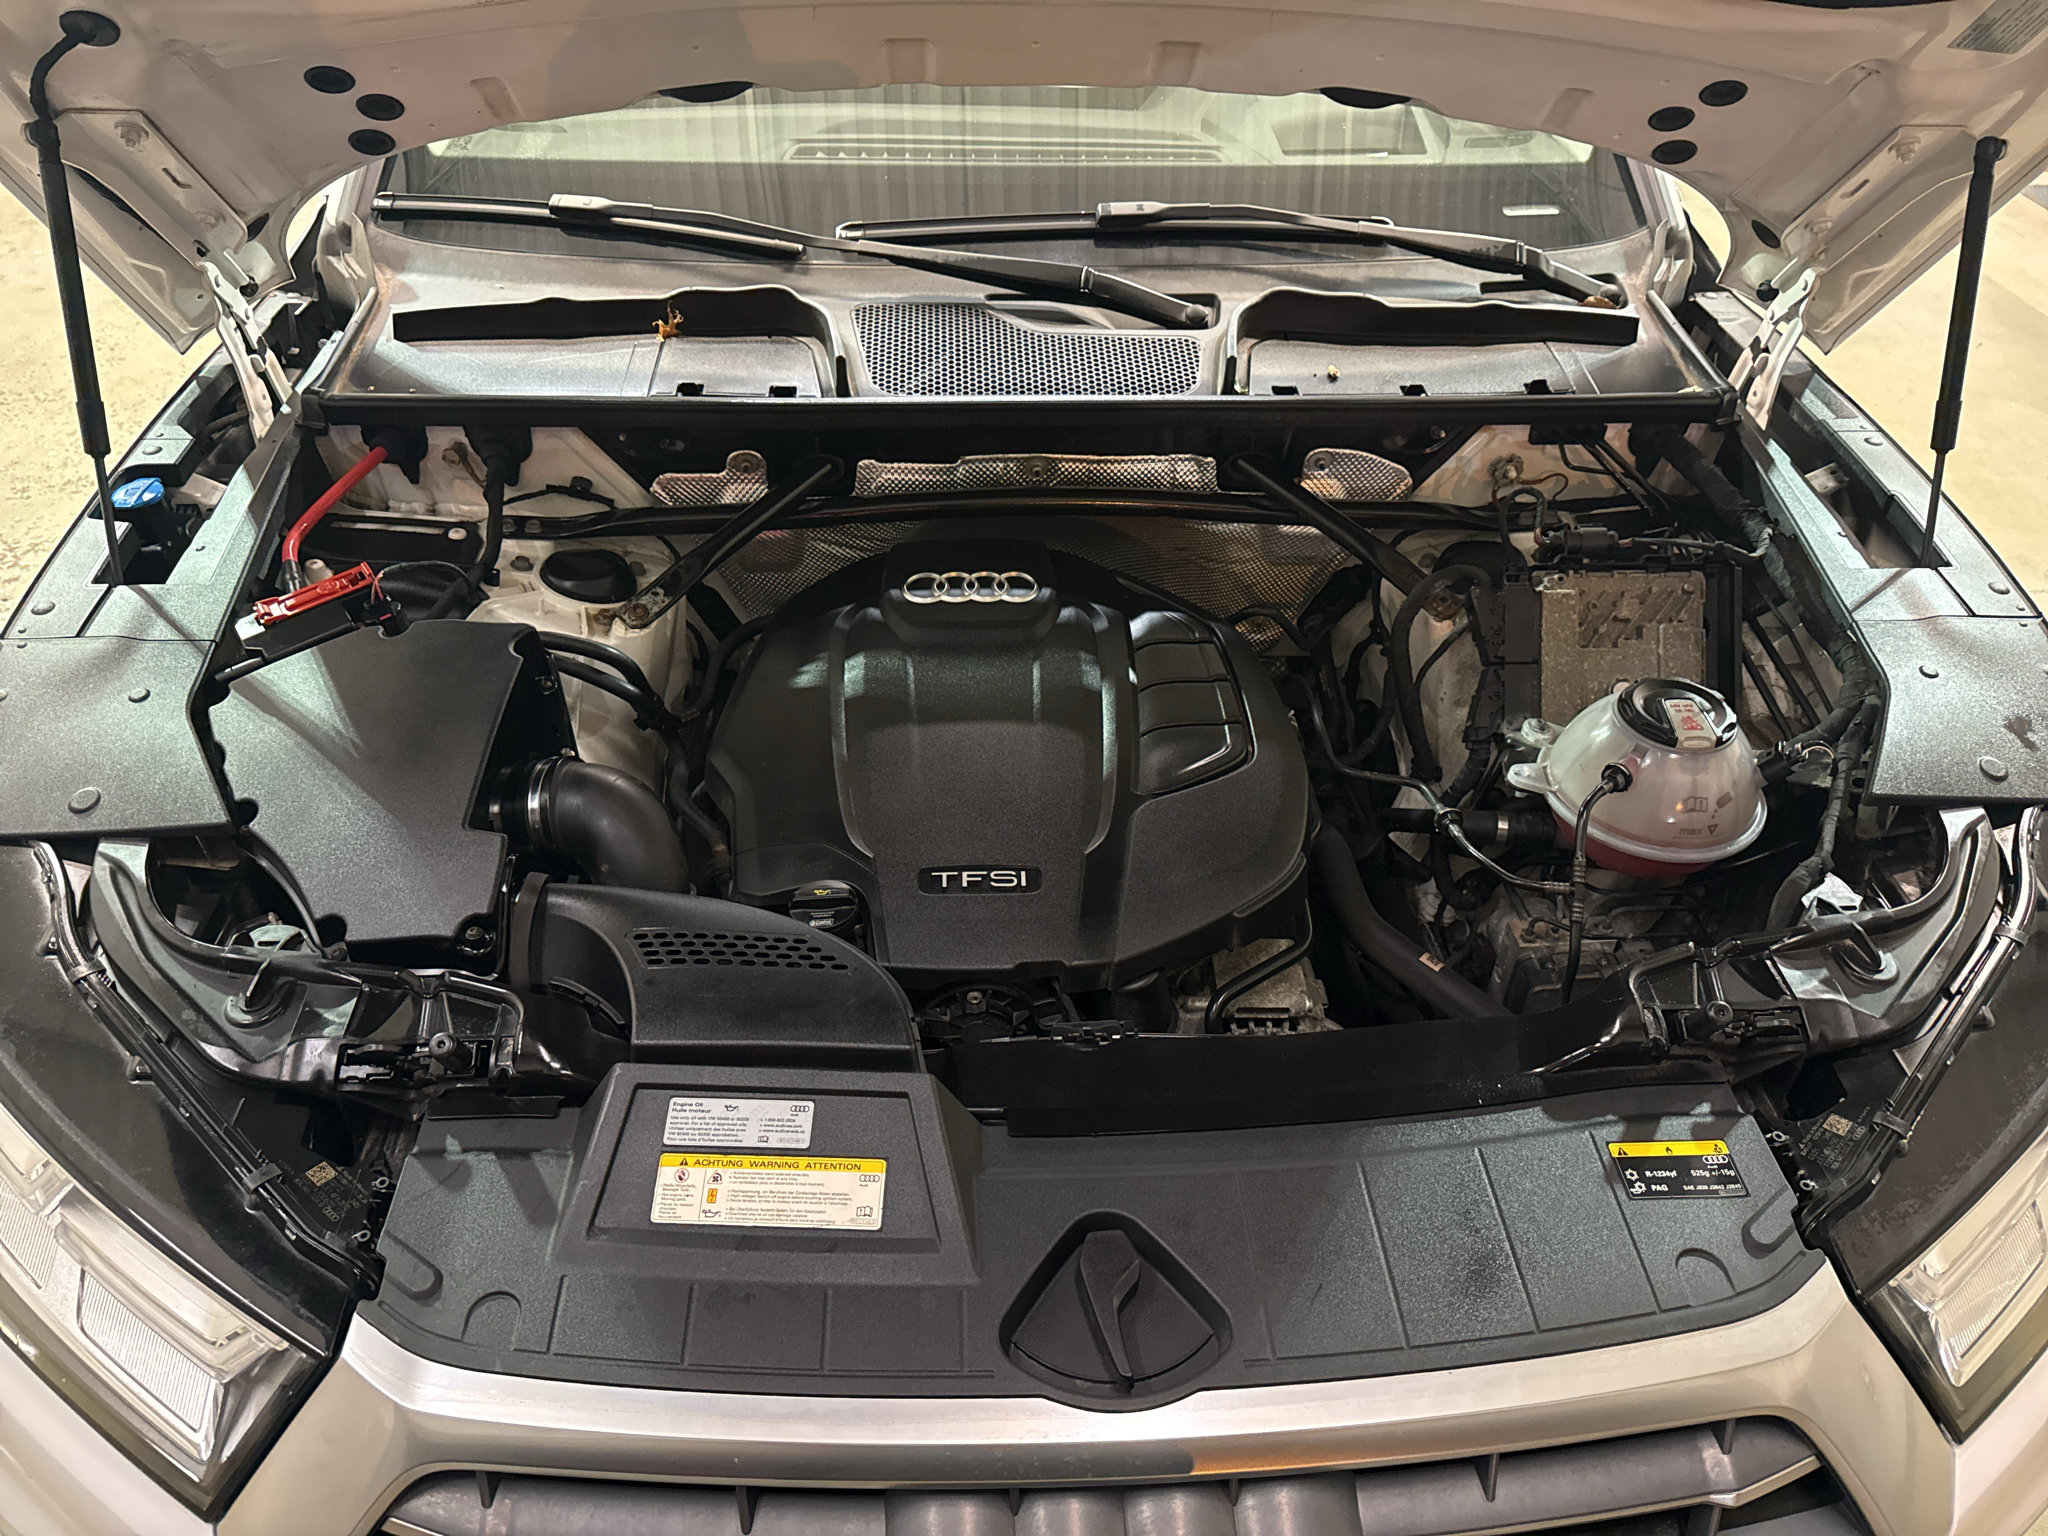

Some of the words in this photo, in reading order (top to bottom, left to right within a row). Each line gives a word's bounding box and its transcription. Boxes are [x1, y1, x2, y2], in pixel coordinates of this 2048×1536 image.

[931, 870, 1027, 888] TFSI
[693, 1158, 743, 1168] ACHTUNG
[749, 1160, 799, 1169] WARNING
[805, 1161, 862, 1171] ATTENTION
[1644, 1170, 1677, 1178] R-1234yf
[1690, 1169, 1710, 1178] 525g
[1650, 1184, 1669, 1192] PAG
